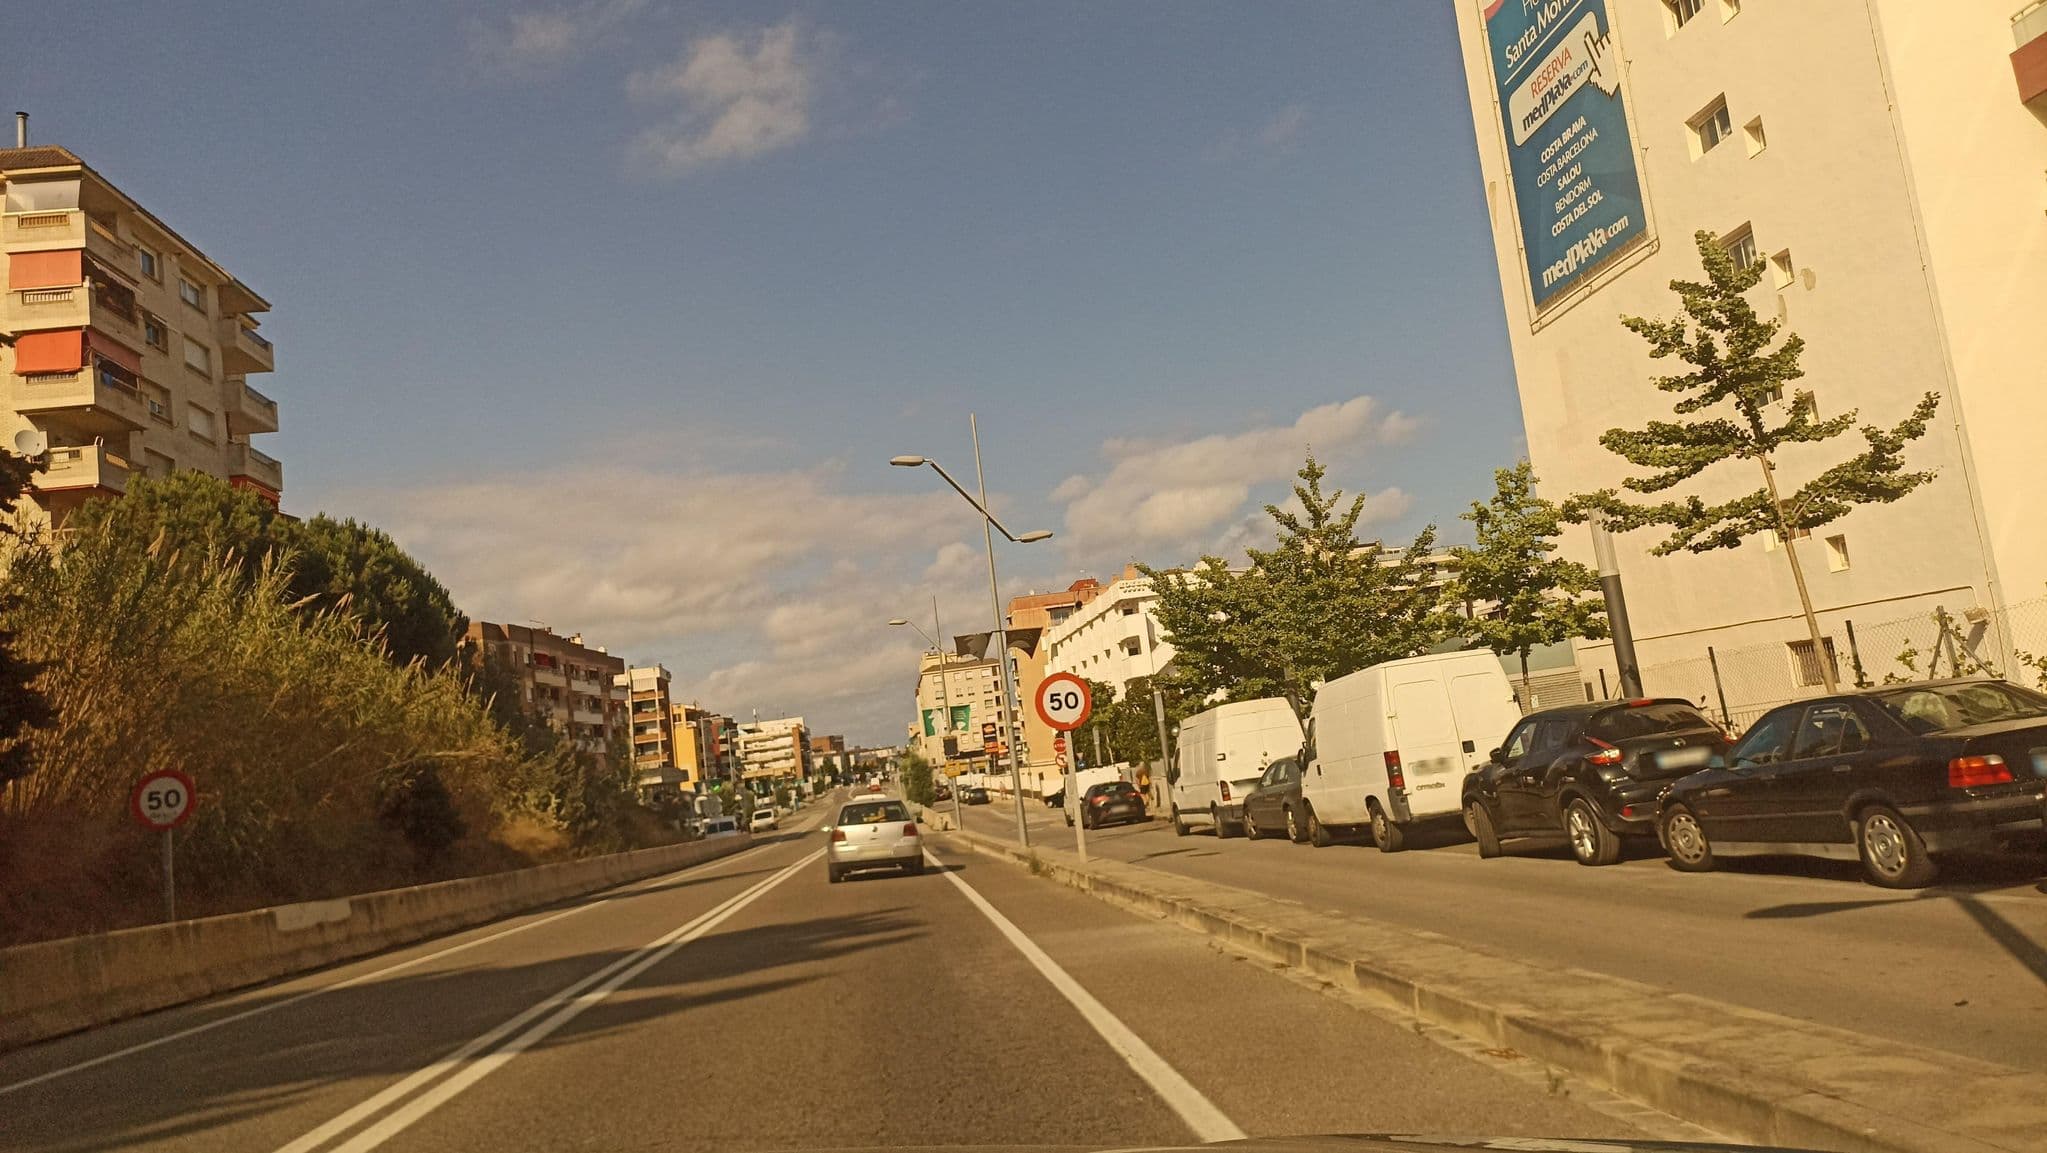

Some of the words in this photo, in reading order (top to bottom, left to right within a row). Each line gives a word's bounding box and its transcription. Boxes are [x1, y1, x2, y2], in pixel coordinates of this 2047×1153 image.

[1505, 25, 1538, 68] Santa
[1537, 0, 1570, 33] Mon
[1531, 47, 1572, 98] RESERVA
[1537, 163, 1558, 187] COSTA
[1557, 127, 1599, 170] BARCELONA
[1541, 137, 1563, 163] COSTA
[1562, 115, 1587, 144] BRAVA
[1555, 176, 1592, 214] BENIDORM
[1557, 162, 1582, 191] SALOU
[1551, 212, 1574, 237] COSTA
[1573, 201, 1588, 220] DEL
[1587, 189, 1604, 209] SOL
[1049, 691, 1079, 711] 50
[148, 789, 181, 810] 50
